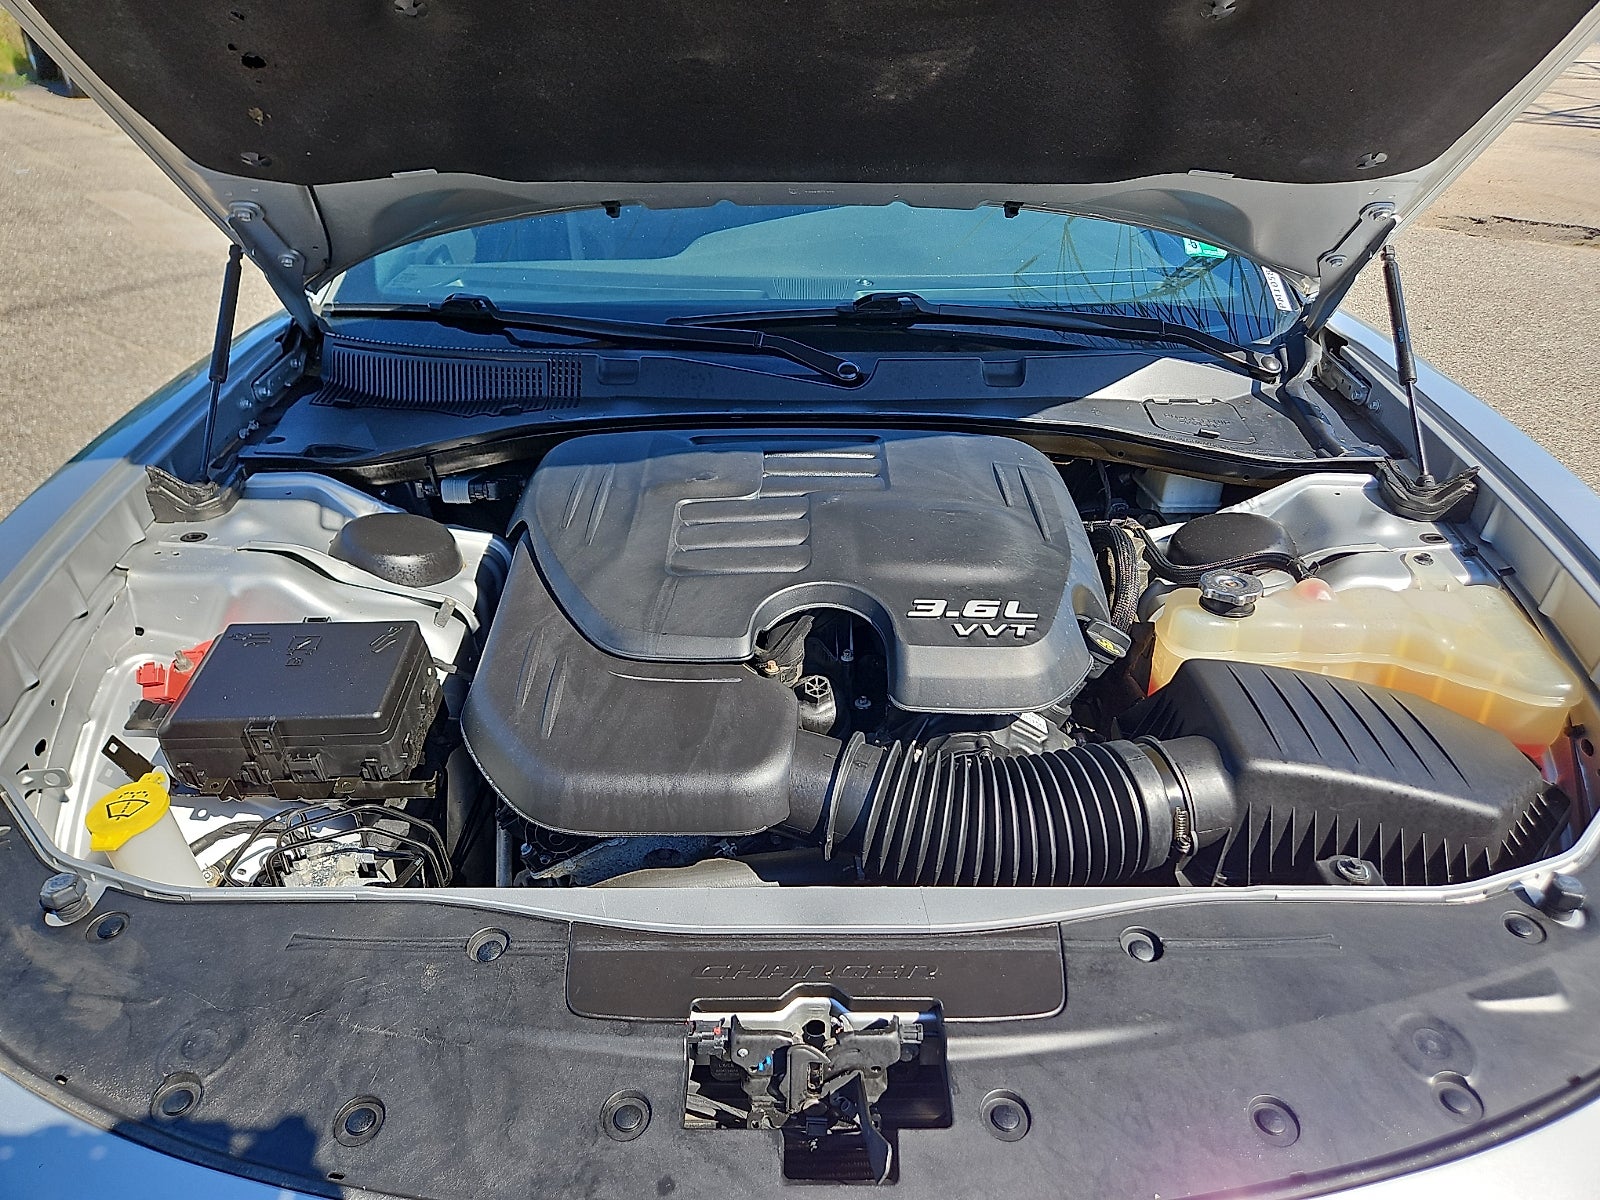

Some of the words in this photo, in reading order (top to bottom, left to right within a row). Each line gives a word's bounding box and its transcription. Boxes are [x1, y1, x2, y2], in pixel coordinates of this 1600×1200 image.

[906, 598, 1039, 621] 3.6L
[951, 623, 1036, 638] VVT
[691, 963, 939, 980] CHARGER
